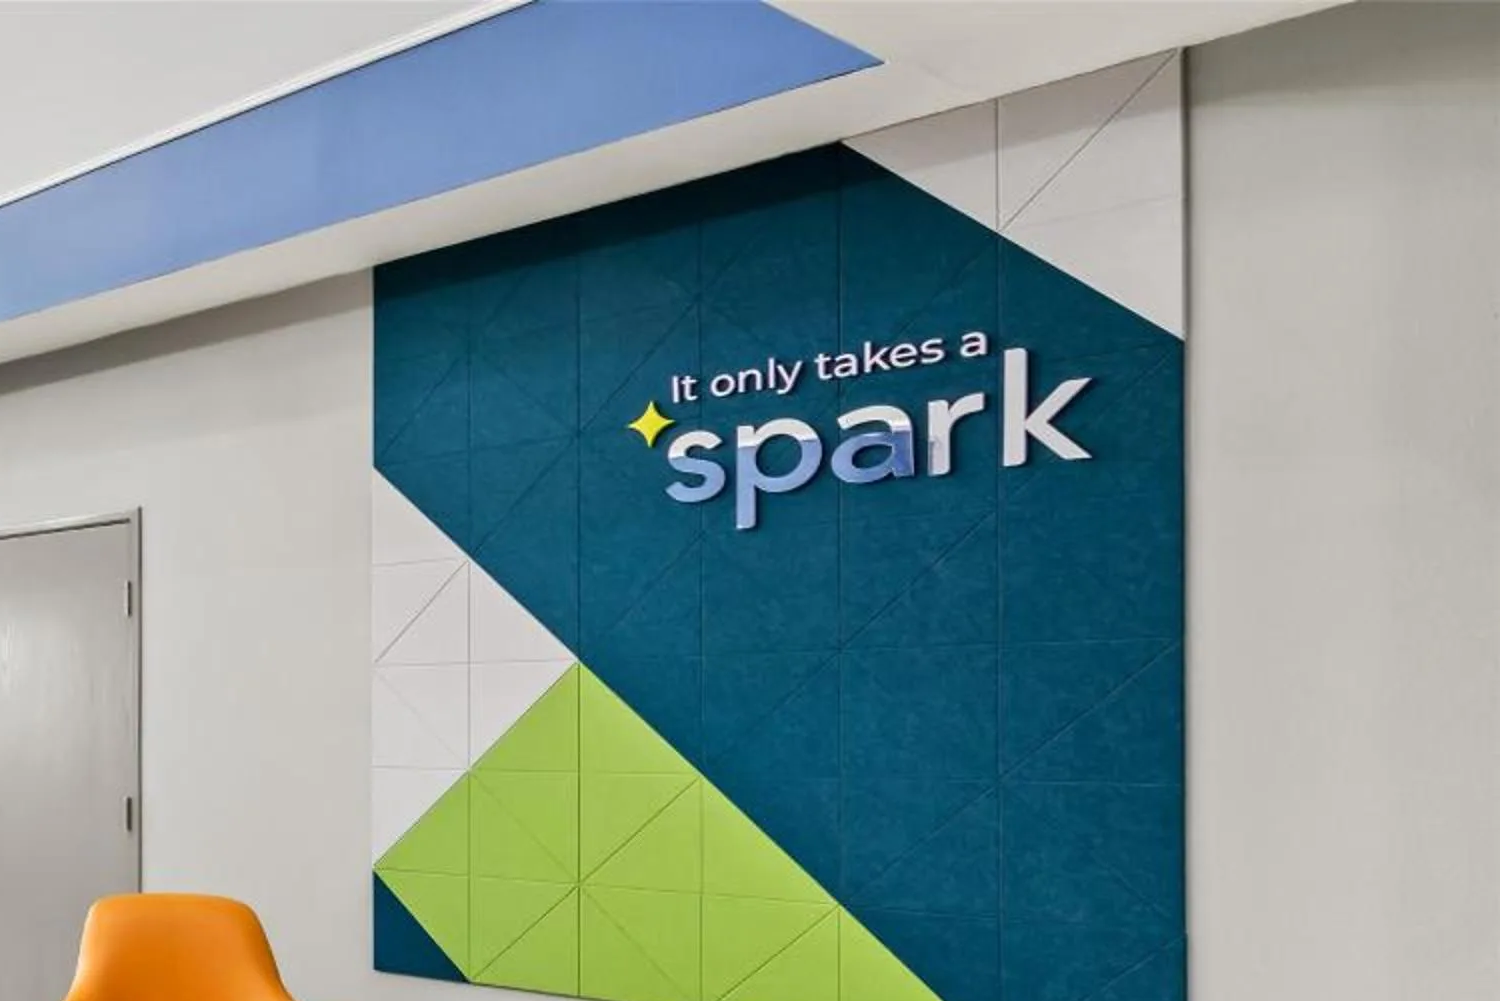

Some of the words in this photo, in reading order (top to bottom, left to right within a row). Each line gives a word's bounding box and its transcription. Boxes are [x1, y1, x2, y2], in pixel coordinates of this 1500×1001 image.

[671, 374, 699, 404] It
[709, 356, 803, 395] only
[814, 340, 946, 381] takes
[959, 330, 989, 357] a
[664, 346, 1094, 531] spark
